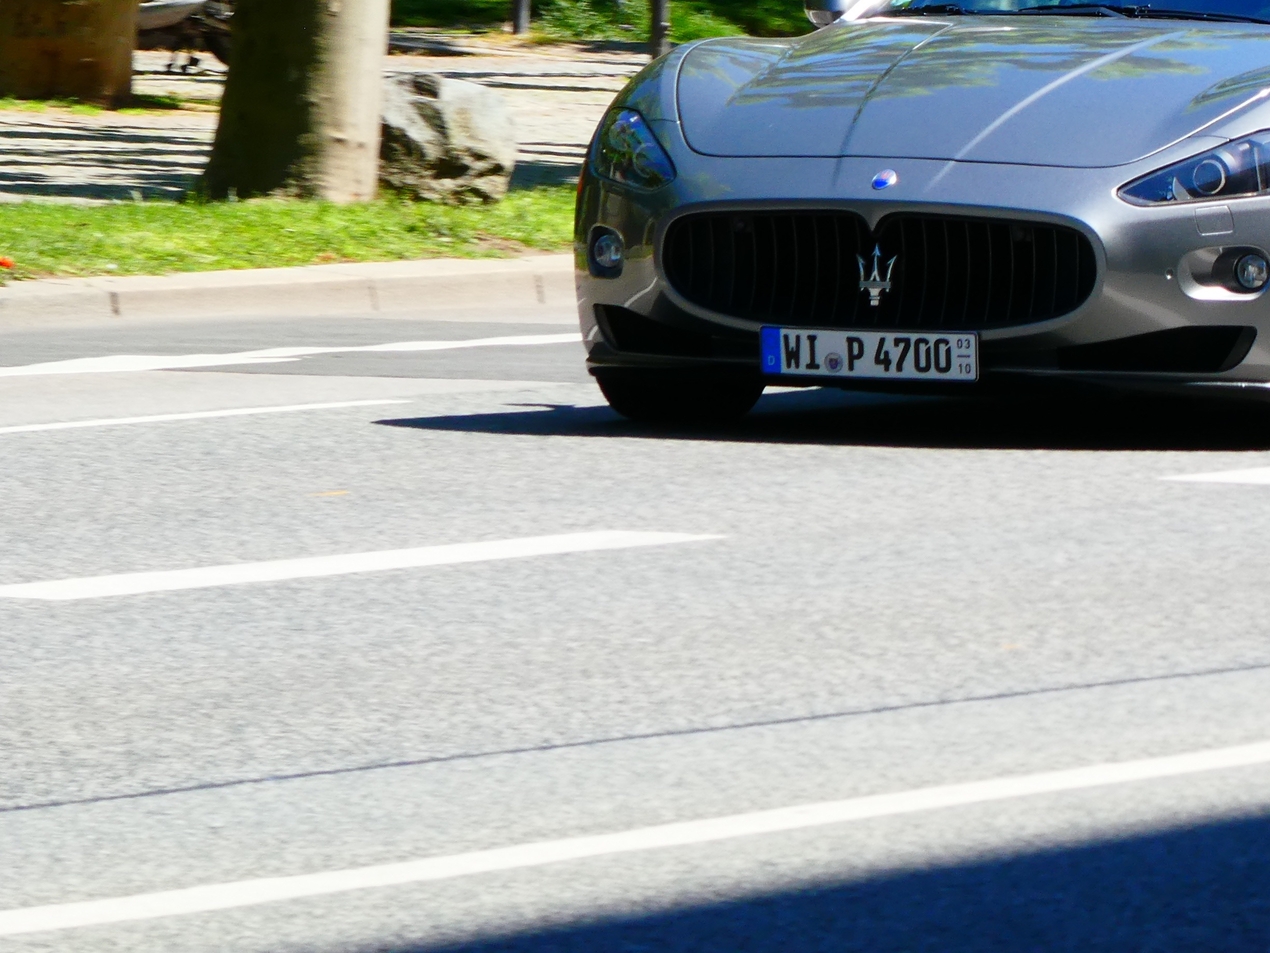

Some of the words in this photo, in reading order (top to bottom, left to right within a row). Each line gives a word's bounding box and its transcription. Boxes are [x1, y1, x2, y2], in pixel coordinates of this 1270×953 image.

[957, 339, 971, 349] 03
[783, 334, 820, 370] WI
[846, 336, 864, 371] P
[874, 337, 951, 373] 4700
[767, 355, 775, 366] D
[958, 363, 971, 374] 10
